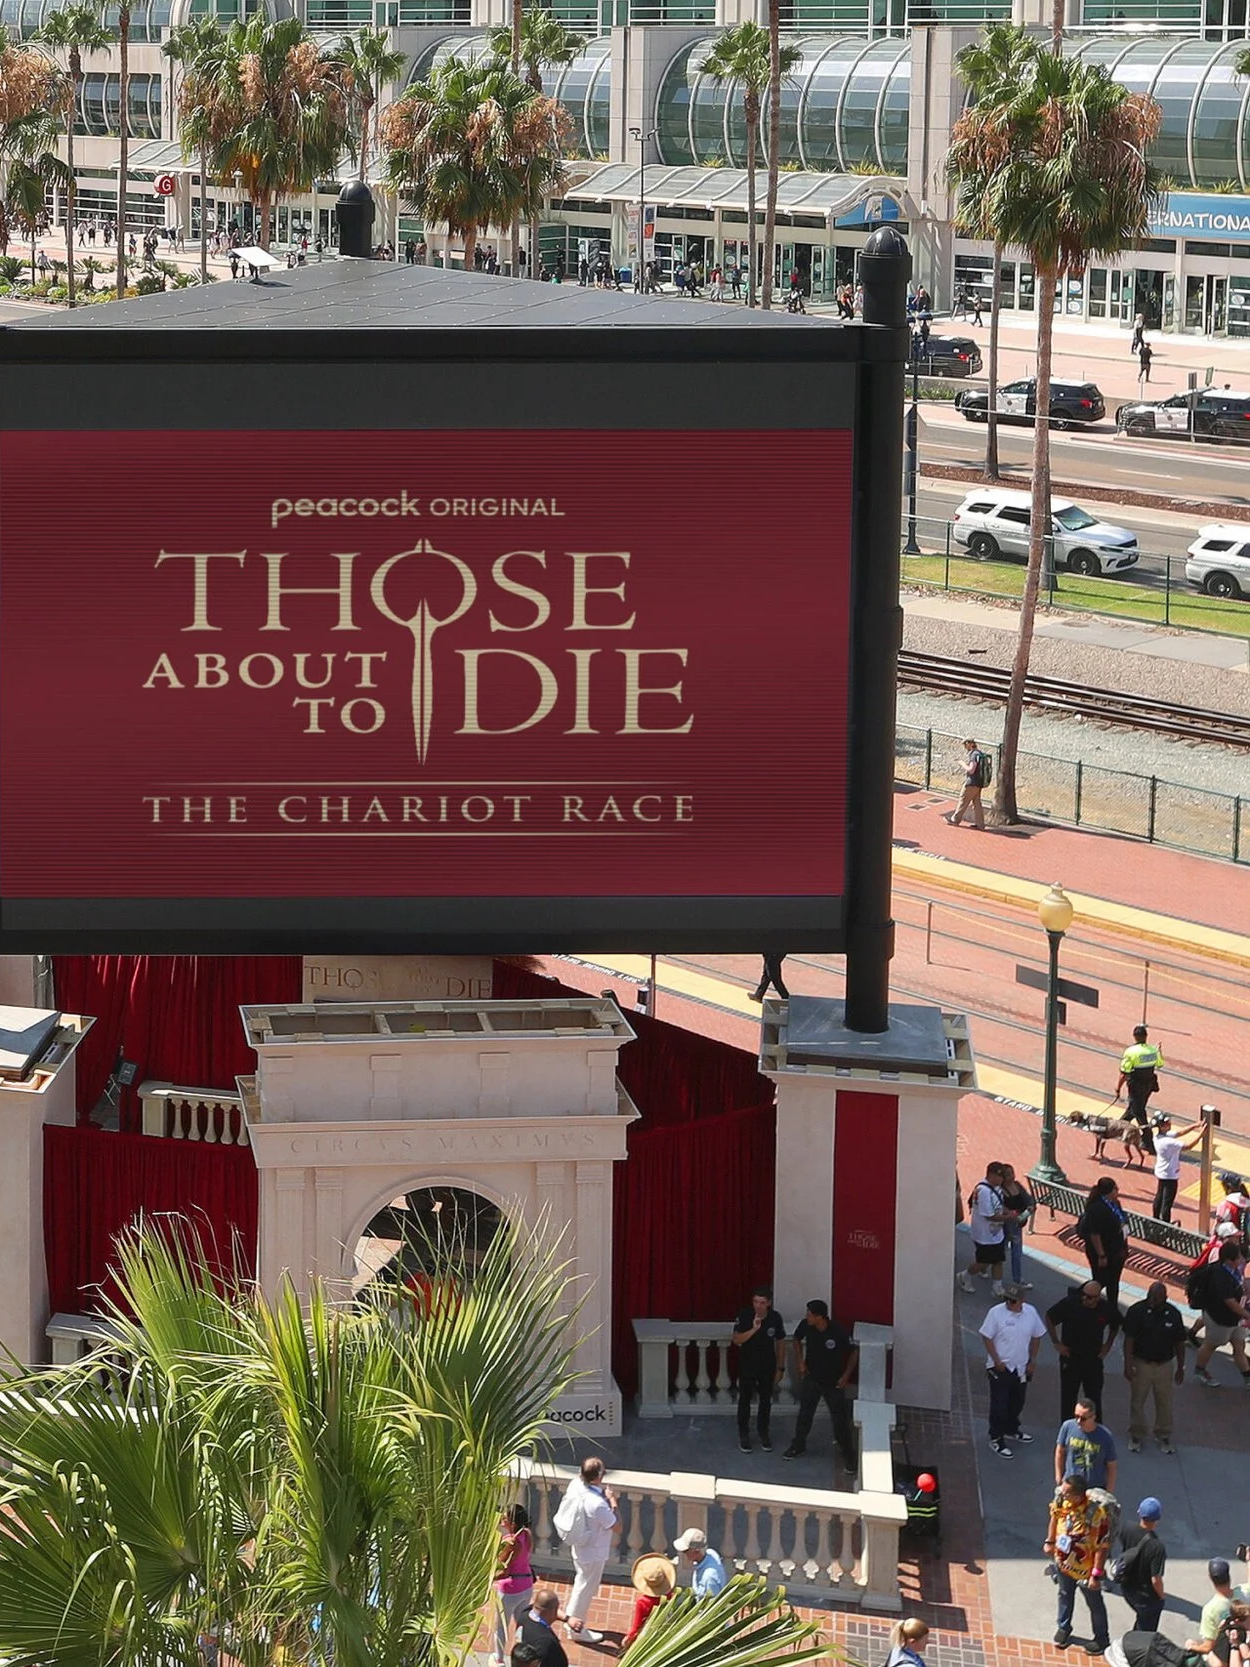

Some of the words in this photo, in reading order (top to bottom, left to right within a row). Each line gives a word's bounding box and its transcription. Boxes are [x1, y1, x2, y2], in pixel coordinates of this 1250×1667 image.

[162, 179, 172, 191] G
[271, 490, 421, 528] peacock
[430, 497, 566, 517] ORIGINAL
[154, 538, 637, 633] THOSE
[142, 651, 388, 690] ABOUT
[292, 696, 387, 735] TO
[453, 647, 695, 736] DIE
[141, 795, 249, 824] THE
[277, 794, 534, 824] CHARIOT
[560, 794, 695, 824] RACE
[445, 976, 492, 999] DIE
[545, 1404, 607, 1422] acock
